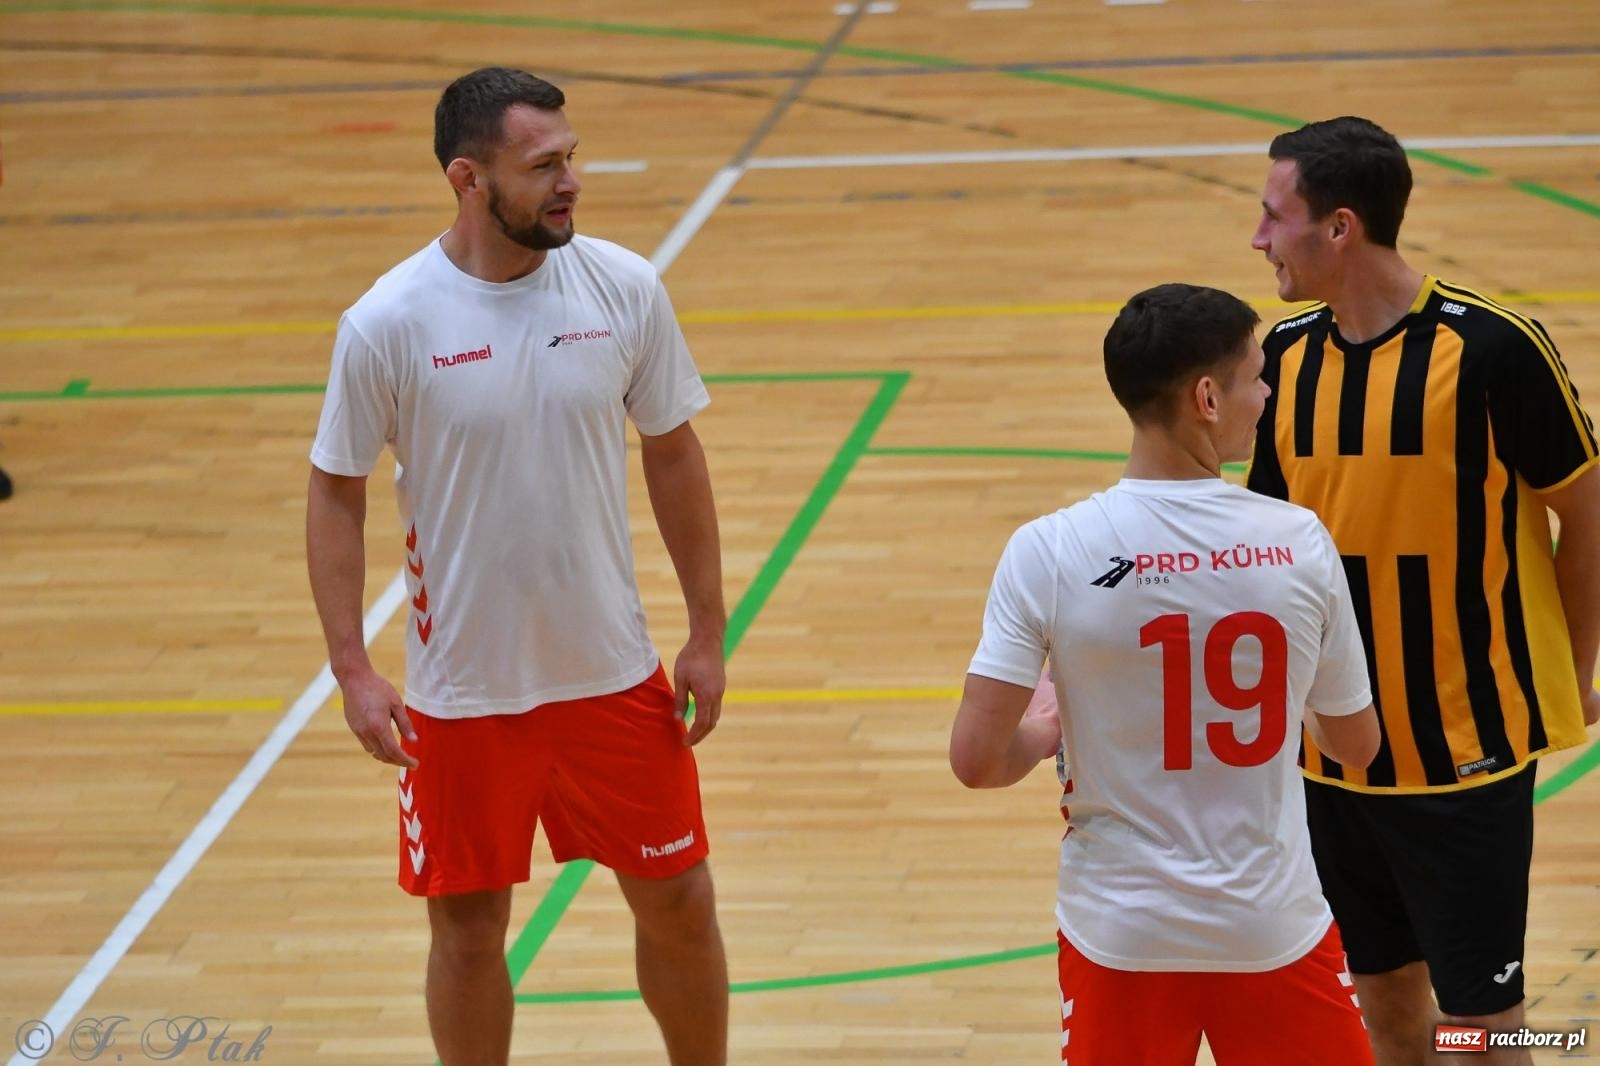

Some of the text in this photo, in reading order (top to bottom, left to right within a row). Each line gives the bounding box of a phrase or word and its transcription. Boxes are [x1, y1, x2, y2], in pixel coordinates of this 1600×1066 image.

[1441, 301, 1467, 316] 1892
[561, 332, 582, 342] PRD
[433, 344, 493, 369] hummel
[1137, 543, 1294, 575] PRD KÜHN
[1138, 575, 1170, 585] 1996
[1139, 611, 1288, 771] 19
[1468, 757, 1496, 769] PATRICK
[641, 829, 695, 859] hummel
